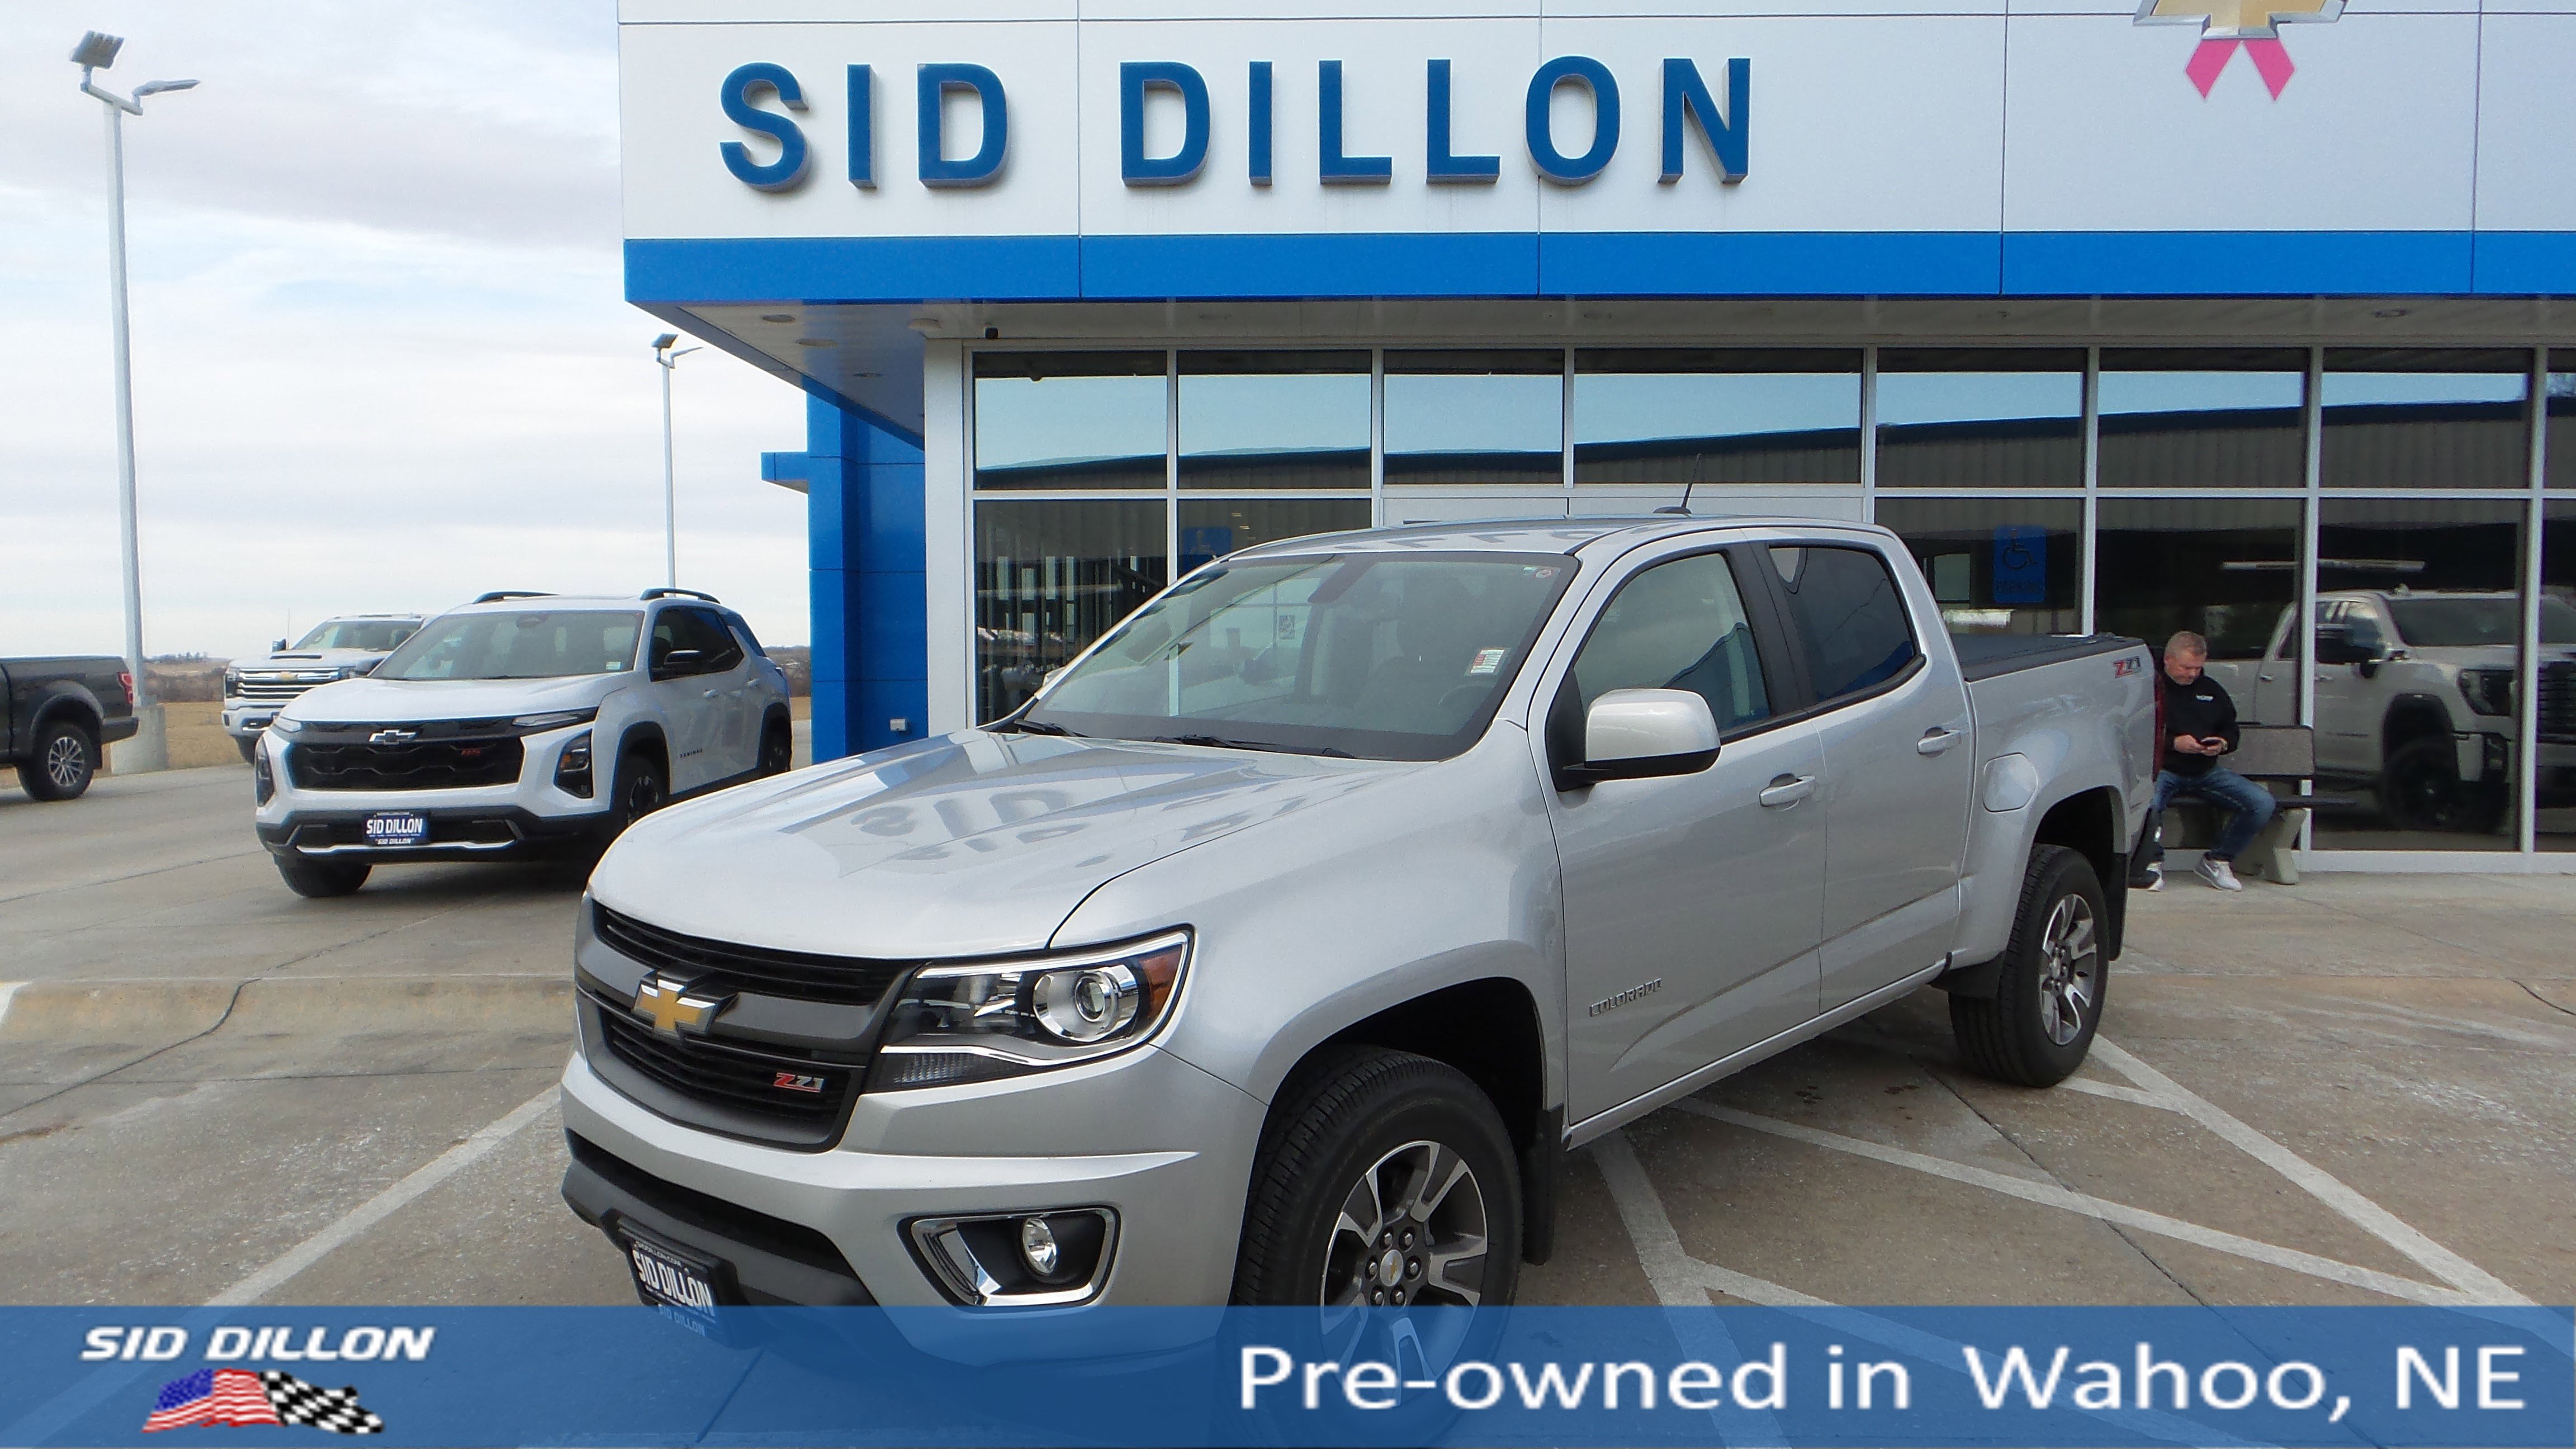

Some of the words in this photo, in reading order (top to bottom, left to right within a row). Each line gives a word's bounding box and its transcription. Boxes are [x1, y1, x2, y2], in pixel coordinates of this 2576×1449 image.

[719, 60, 1008, 190] SID
[1120, 54, 1750, 187] DILLON
[2113, 656, 2141, 678] Z71
[366, 818, 384, 835] SID
[386, 817, 423, 834] DILLON
[774, 1072, 826, 1093] Z71
[632, 1249, 660, 1290] SID
[656, 1261, 716, 1317] DILLON
